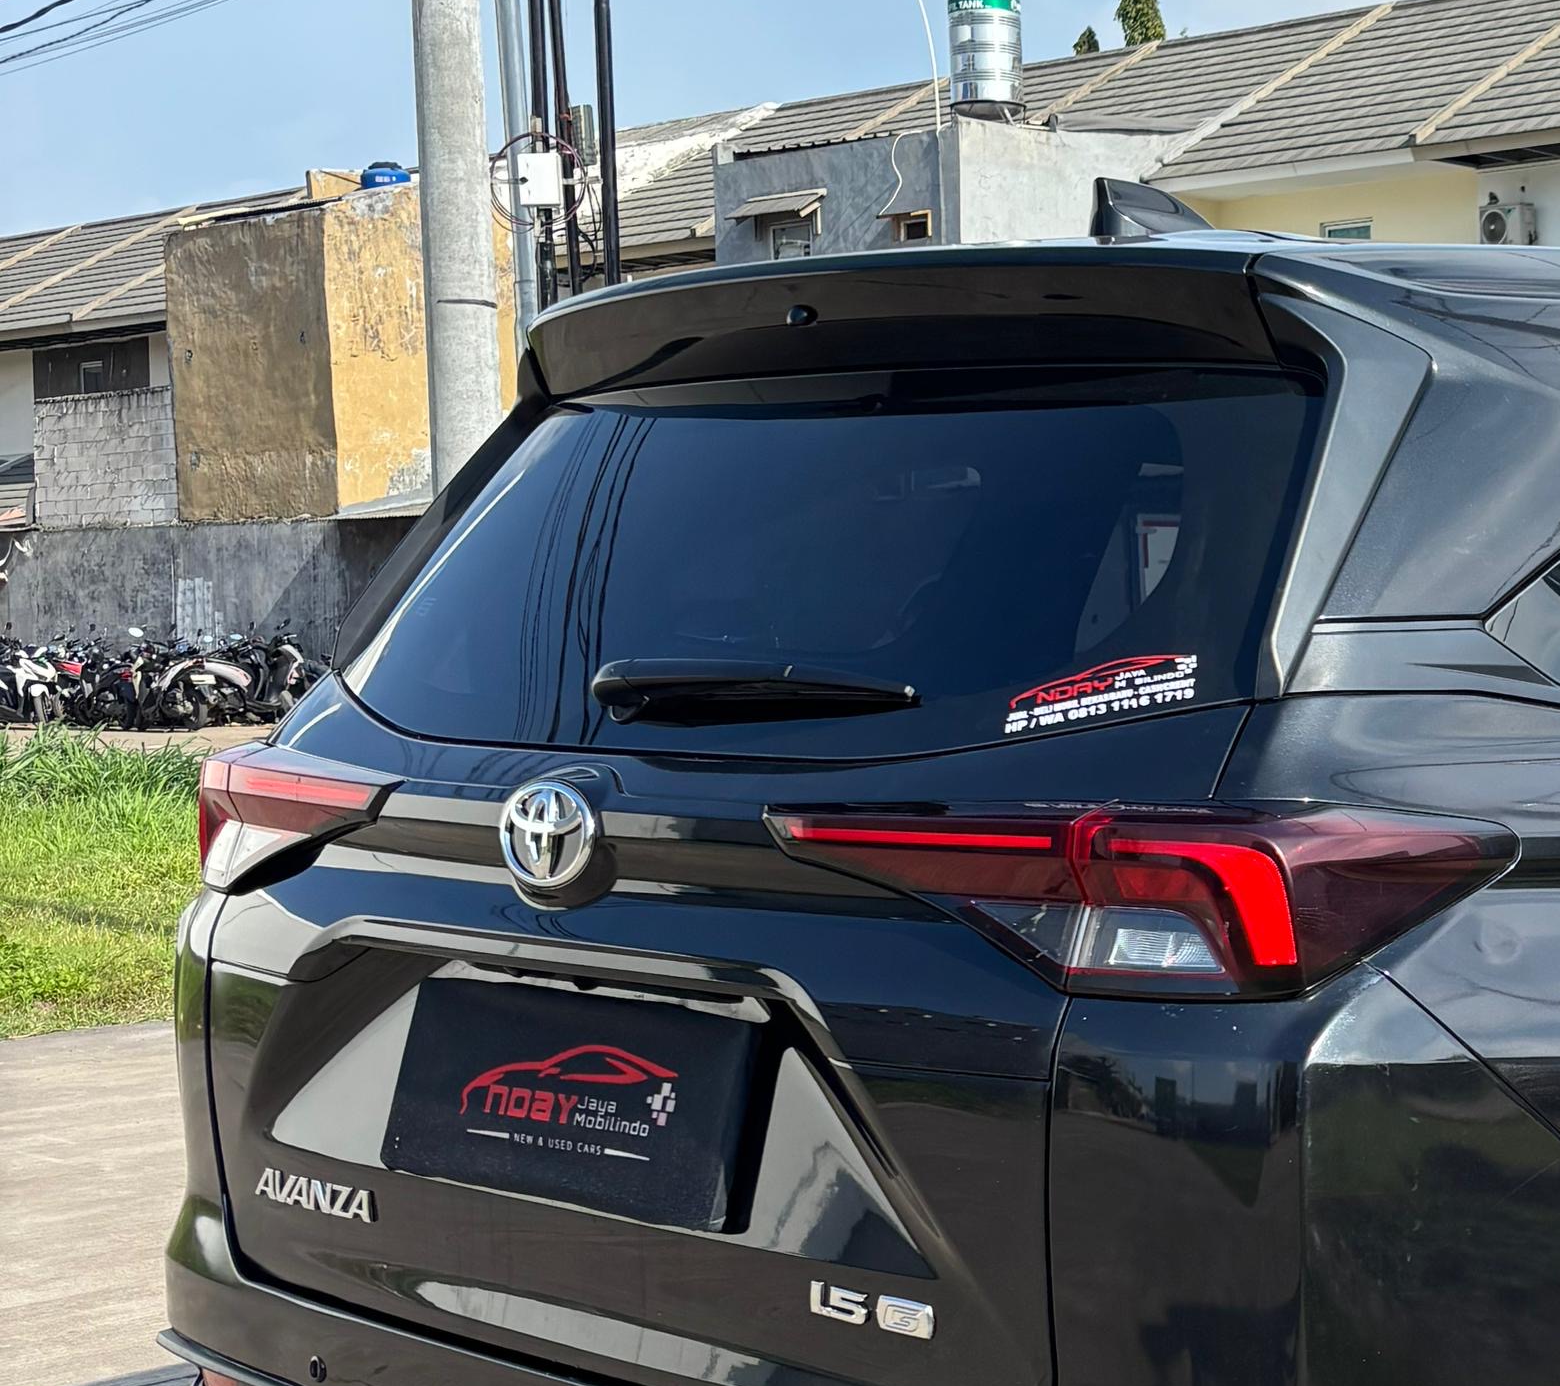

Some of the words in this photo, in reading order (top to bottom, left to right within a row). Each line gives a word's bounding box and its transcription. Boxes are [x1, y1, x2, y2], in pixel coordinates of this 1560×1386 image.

[958, 0, 984, 10] TANK
[1114, 669, 1147, 681] JAYA
[1004, 719, 1028, 734] HP
[1038, 712, 1065, 727] WA
[1067, 702, 1107, 720] 0813
[577, 1095, 617, 1116] Jaya
[573, 1112, 650, 1137] Mobilindo
[513, 1132, 534, 1145] NEW
[548, 1137, 573, 1151] USED
[576, 1141, 602, 1156] CARS
[255, 1167, 373, 1224] AVANZA
